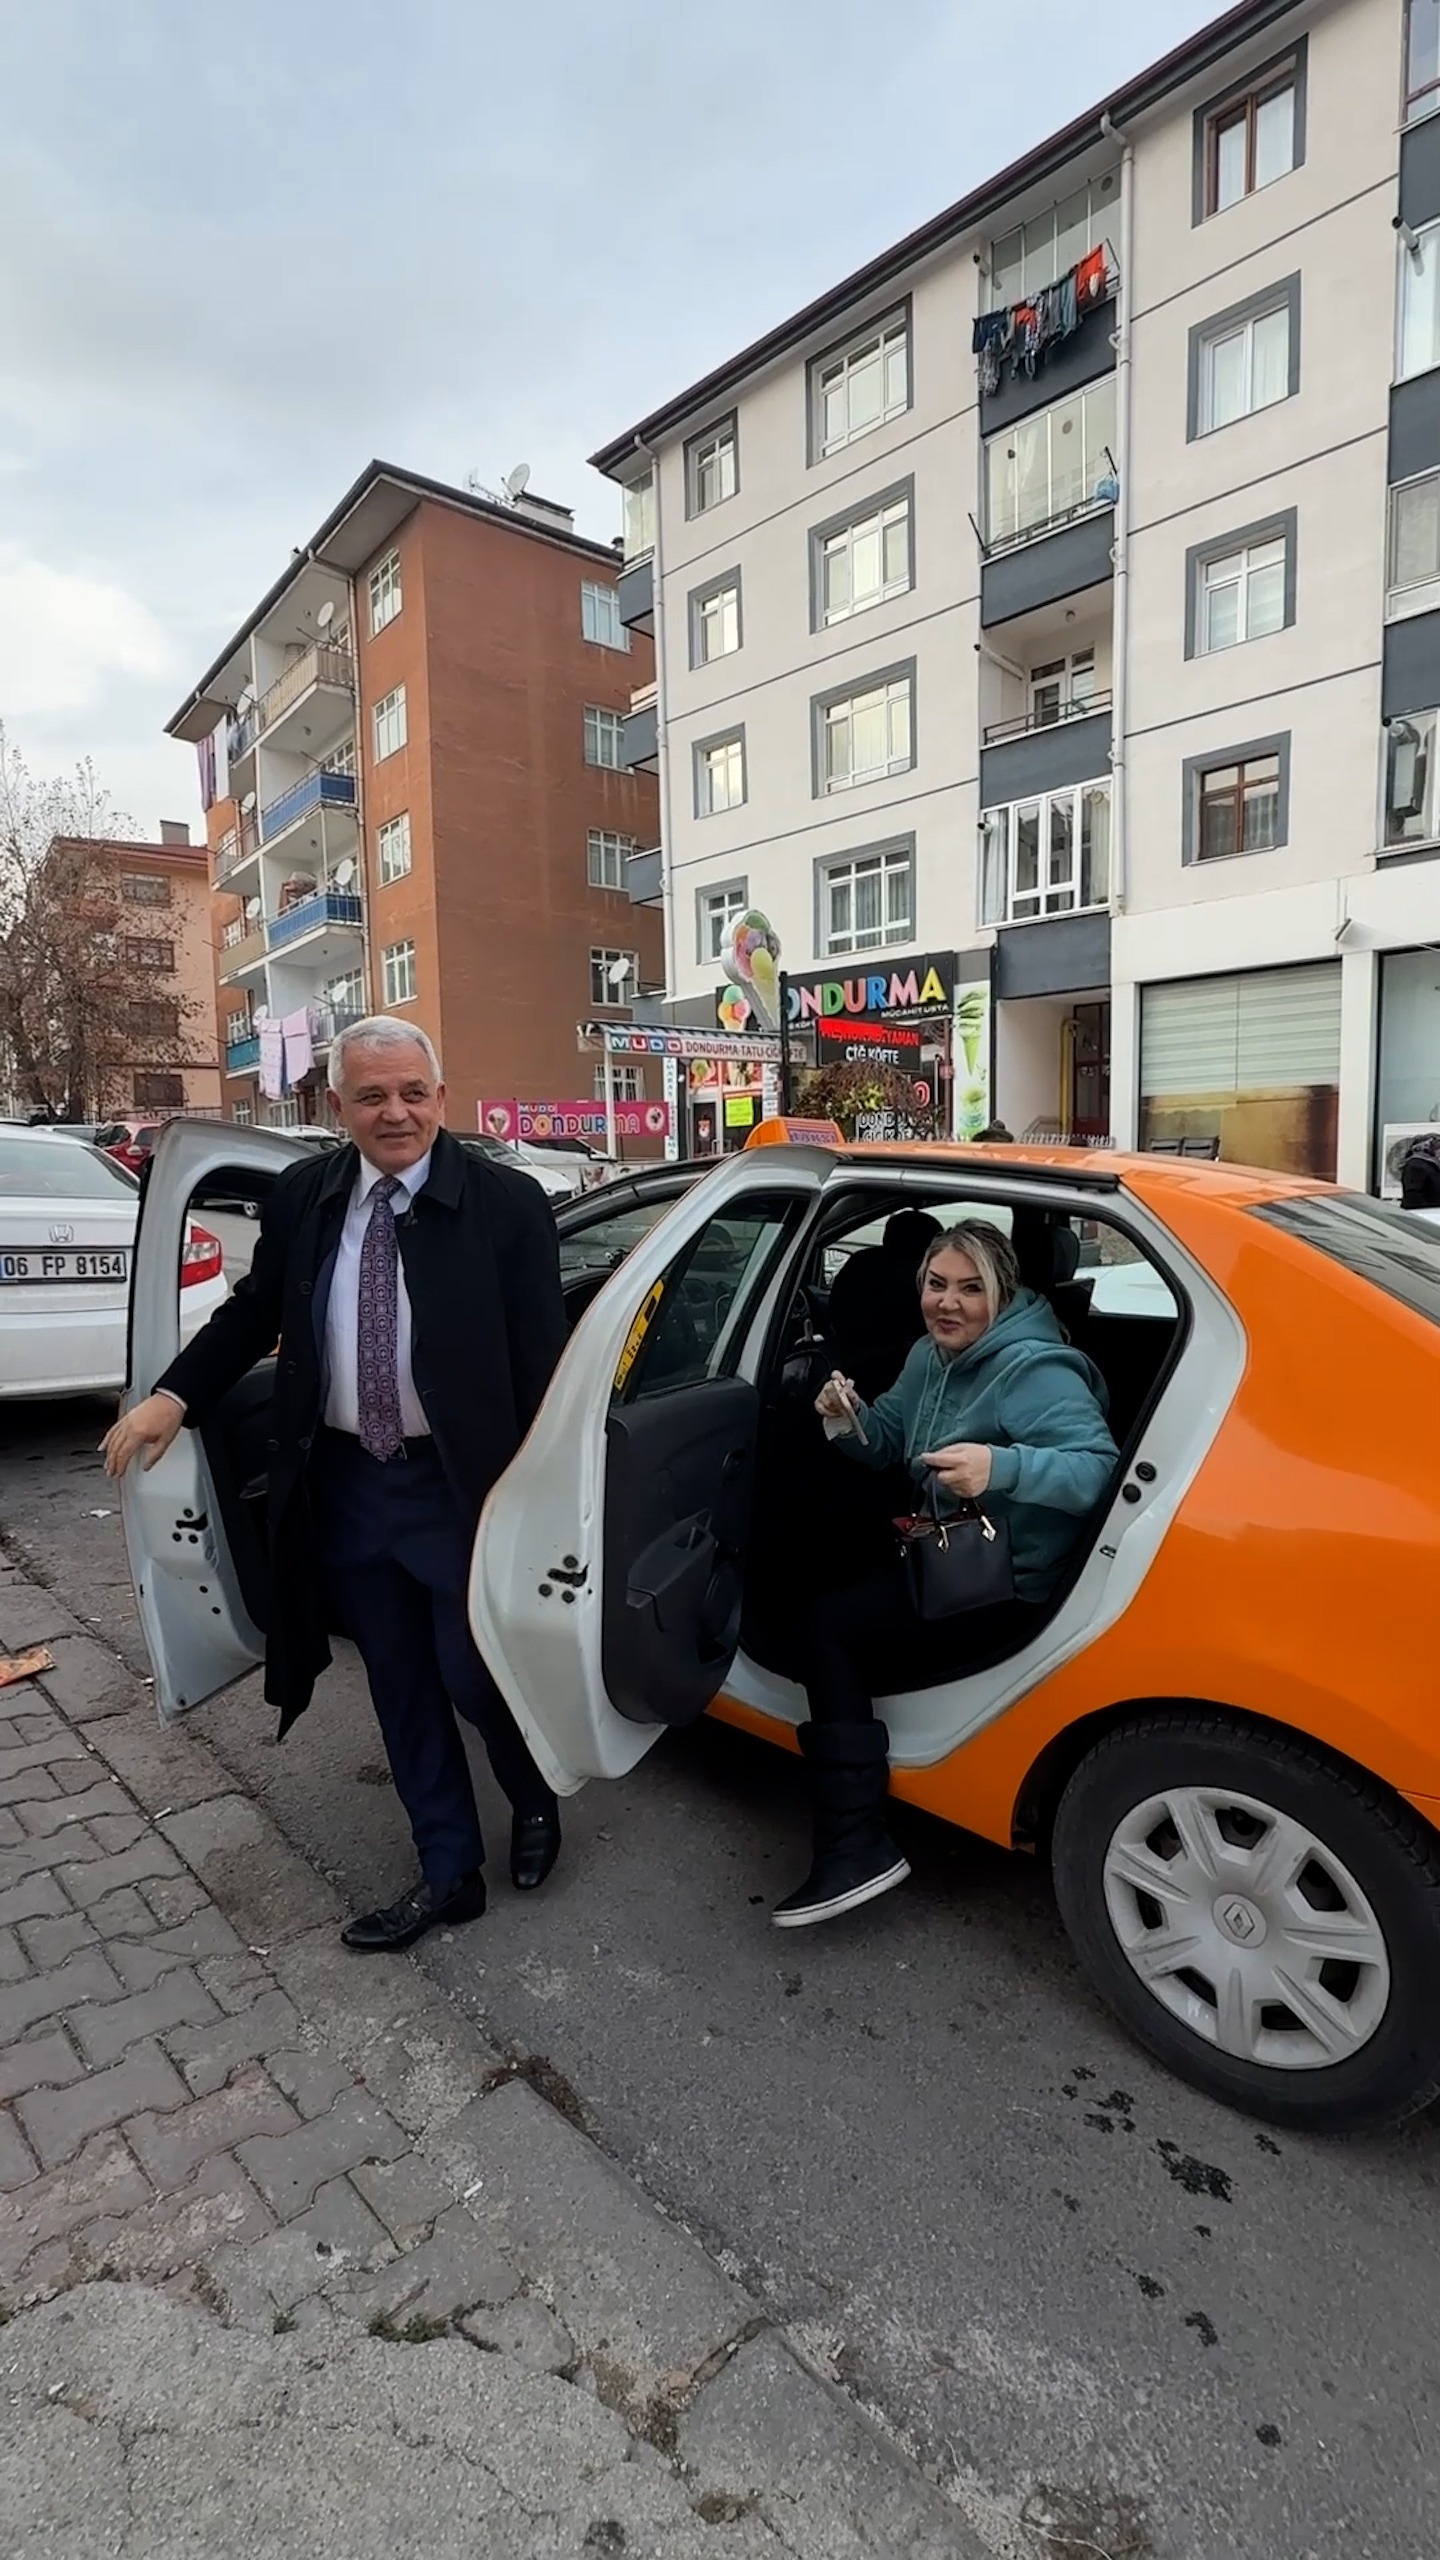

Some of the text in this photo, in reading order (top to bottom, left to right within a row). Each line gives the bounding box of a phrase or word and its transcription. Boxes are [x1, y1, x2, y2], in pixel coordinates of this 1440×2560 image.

[787, 966, 947, 1021] ONDURMA
[867, 1046, 900, 1065] KÖFTE
[4, 1256, 121, 1276] 06 FP 8154
